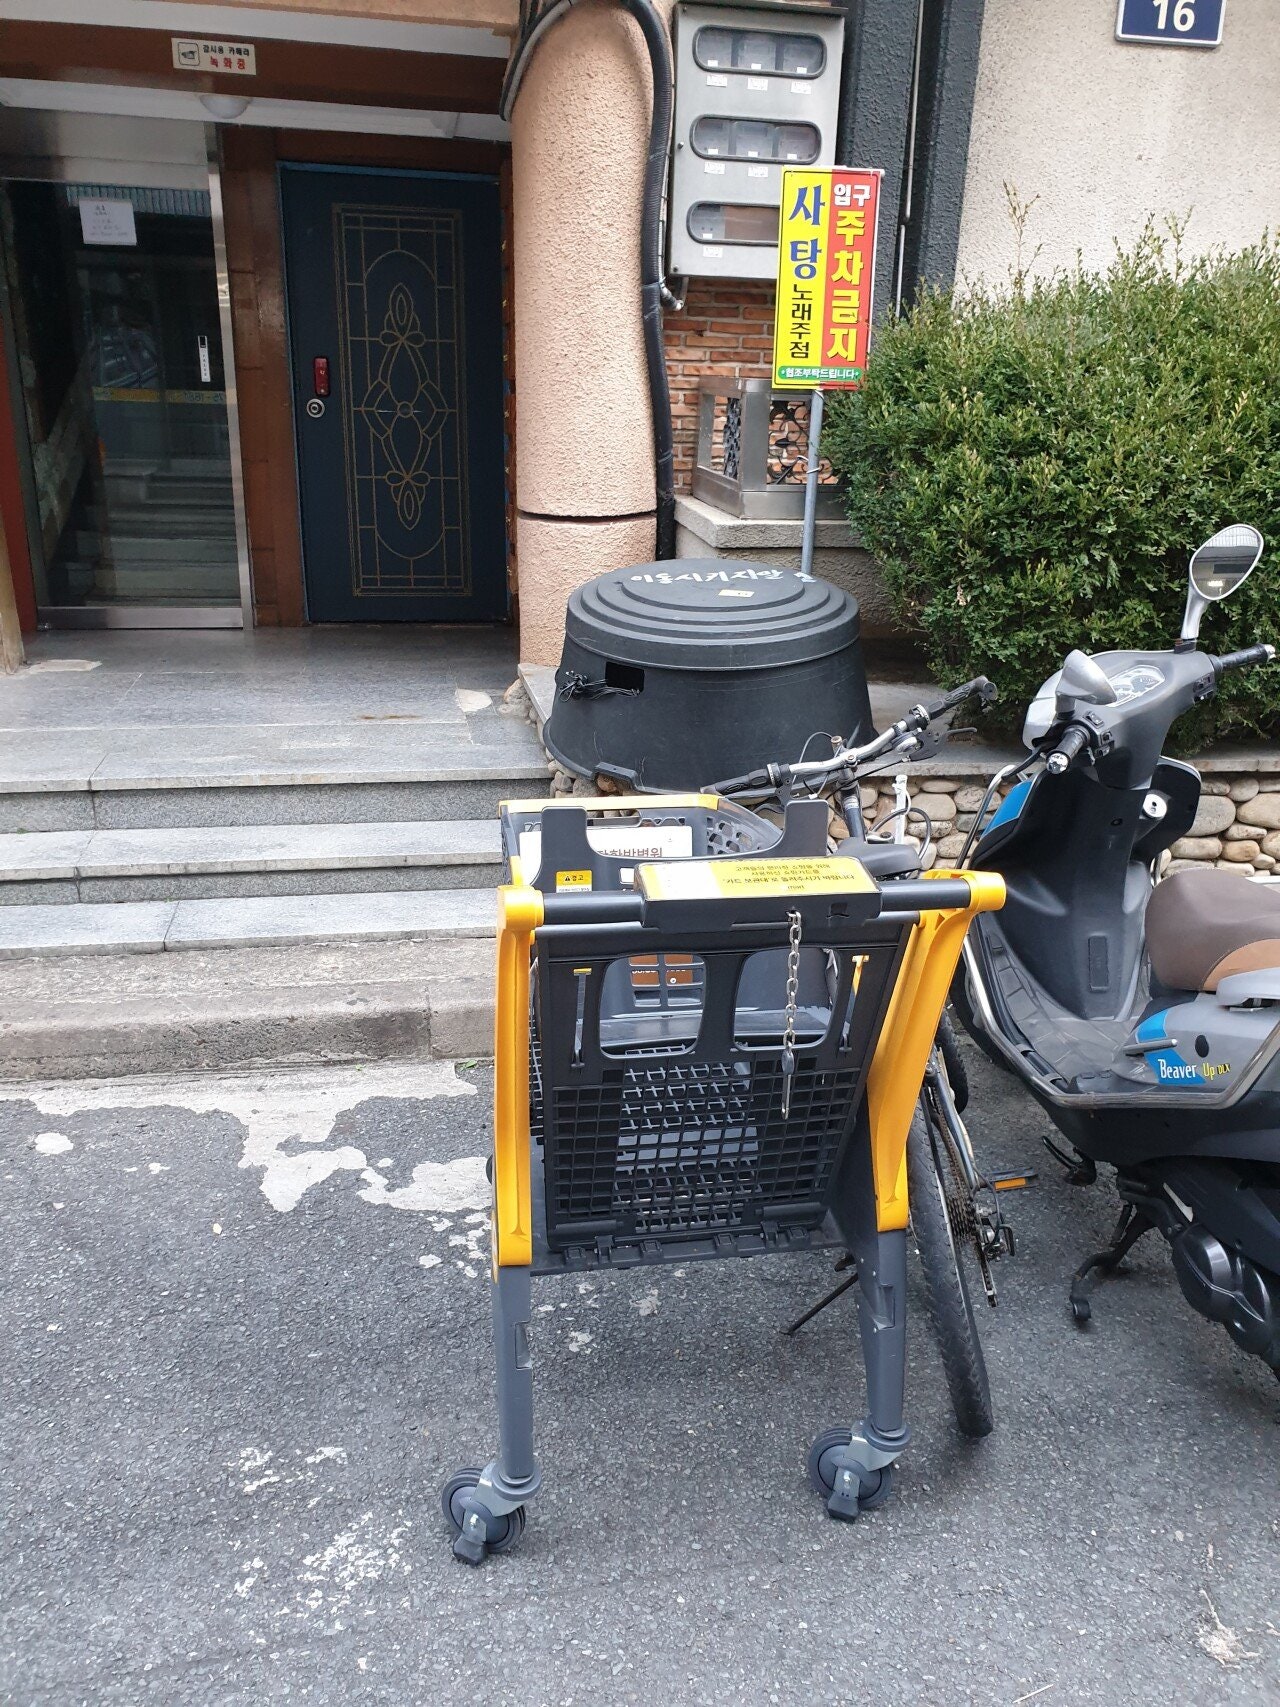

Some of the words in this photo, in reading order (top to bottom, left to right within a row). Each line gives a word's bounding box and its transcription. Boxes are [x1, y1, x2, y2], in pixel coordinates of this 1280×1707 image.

[1153, 0, 1195, 32] 16
[202, 44, 224, 55] 감시용
[228, 46, 250, 57] 카메라
[833, 183, 871, 207] 입구
[788, 184, 826, 280] 사탕
[826, 210, 865, 363] 주차금지
[789, 283, 813, 359] 노래주점
[785, 367, 855, 379] 협조부탁드립니다
[1158, 1059, 1197, 1079] Beaver
[1202, 1062, 1216, 1081] Up
[1217, 1063, 1231, 1075] DLX
